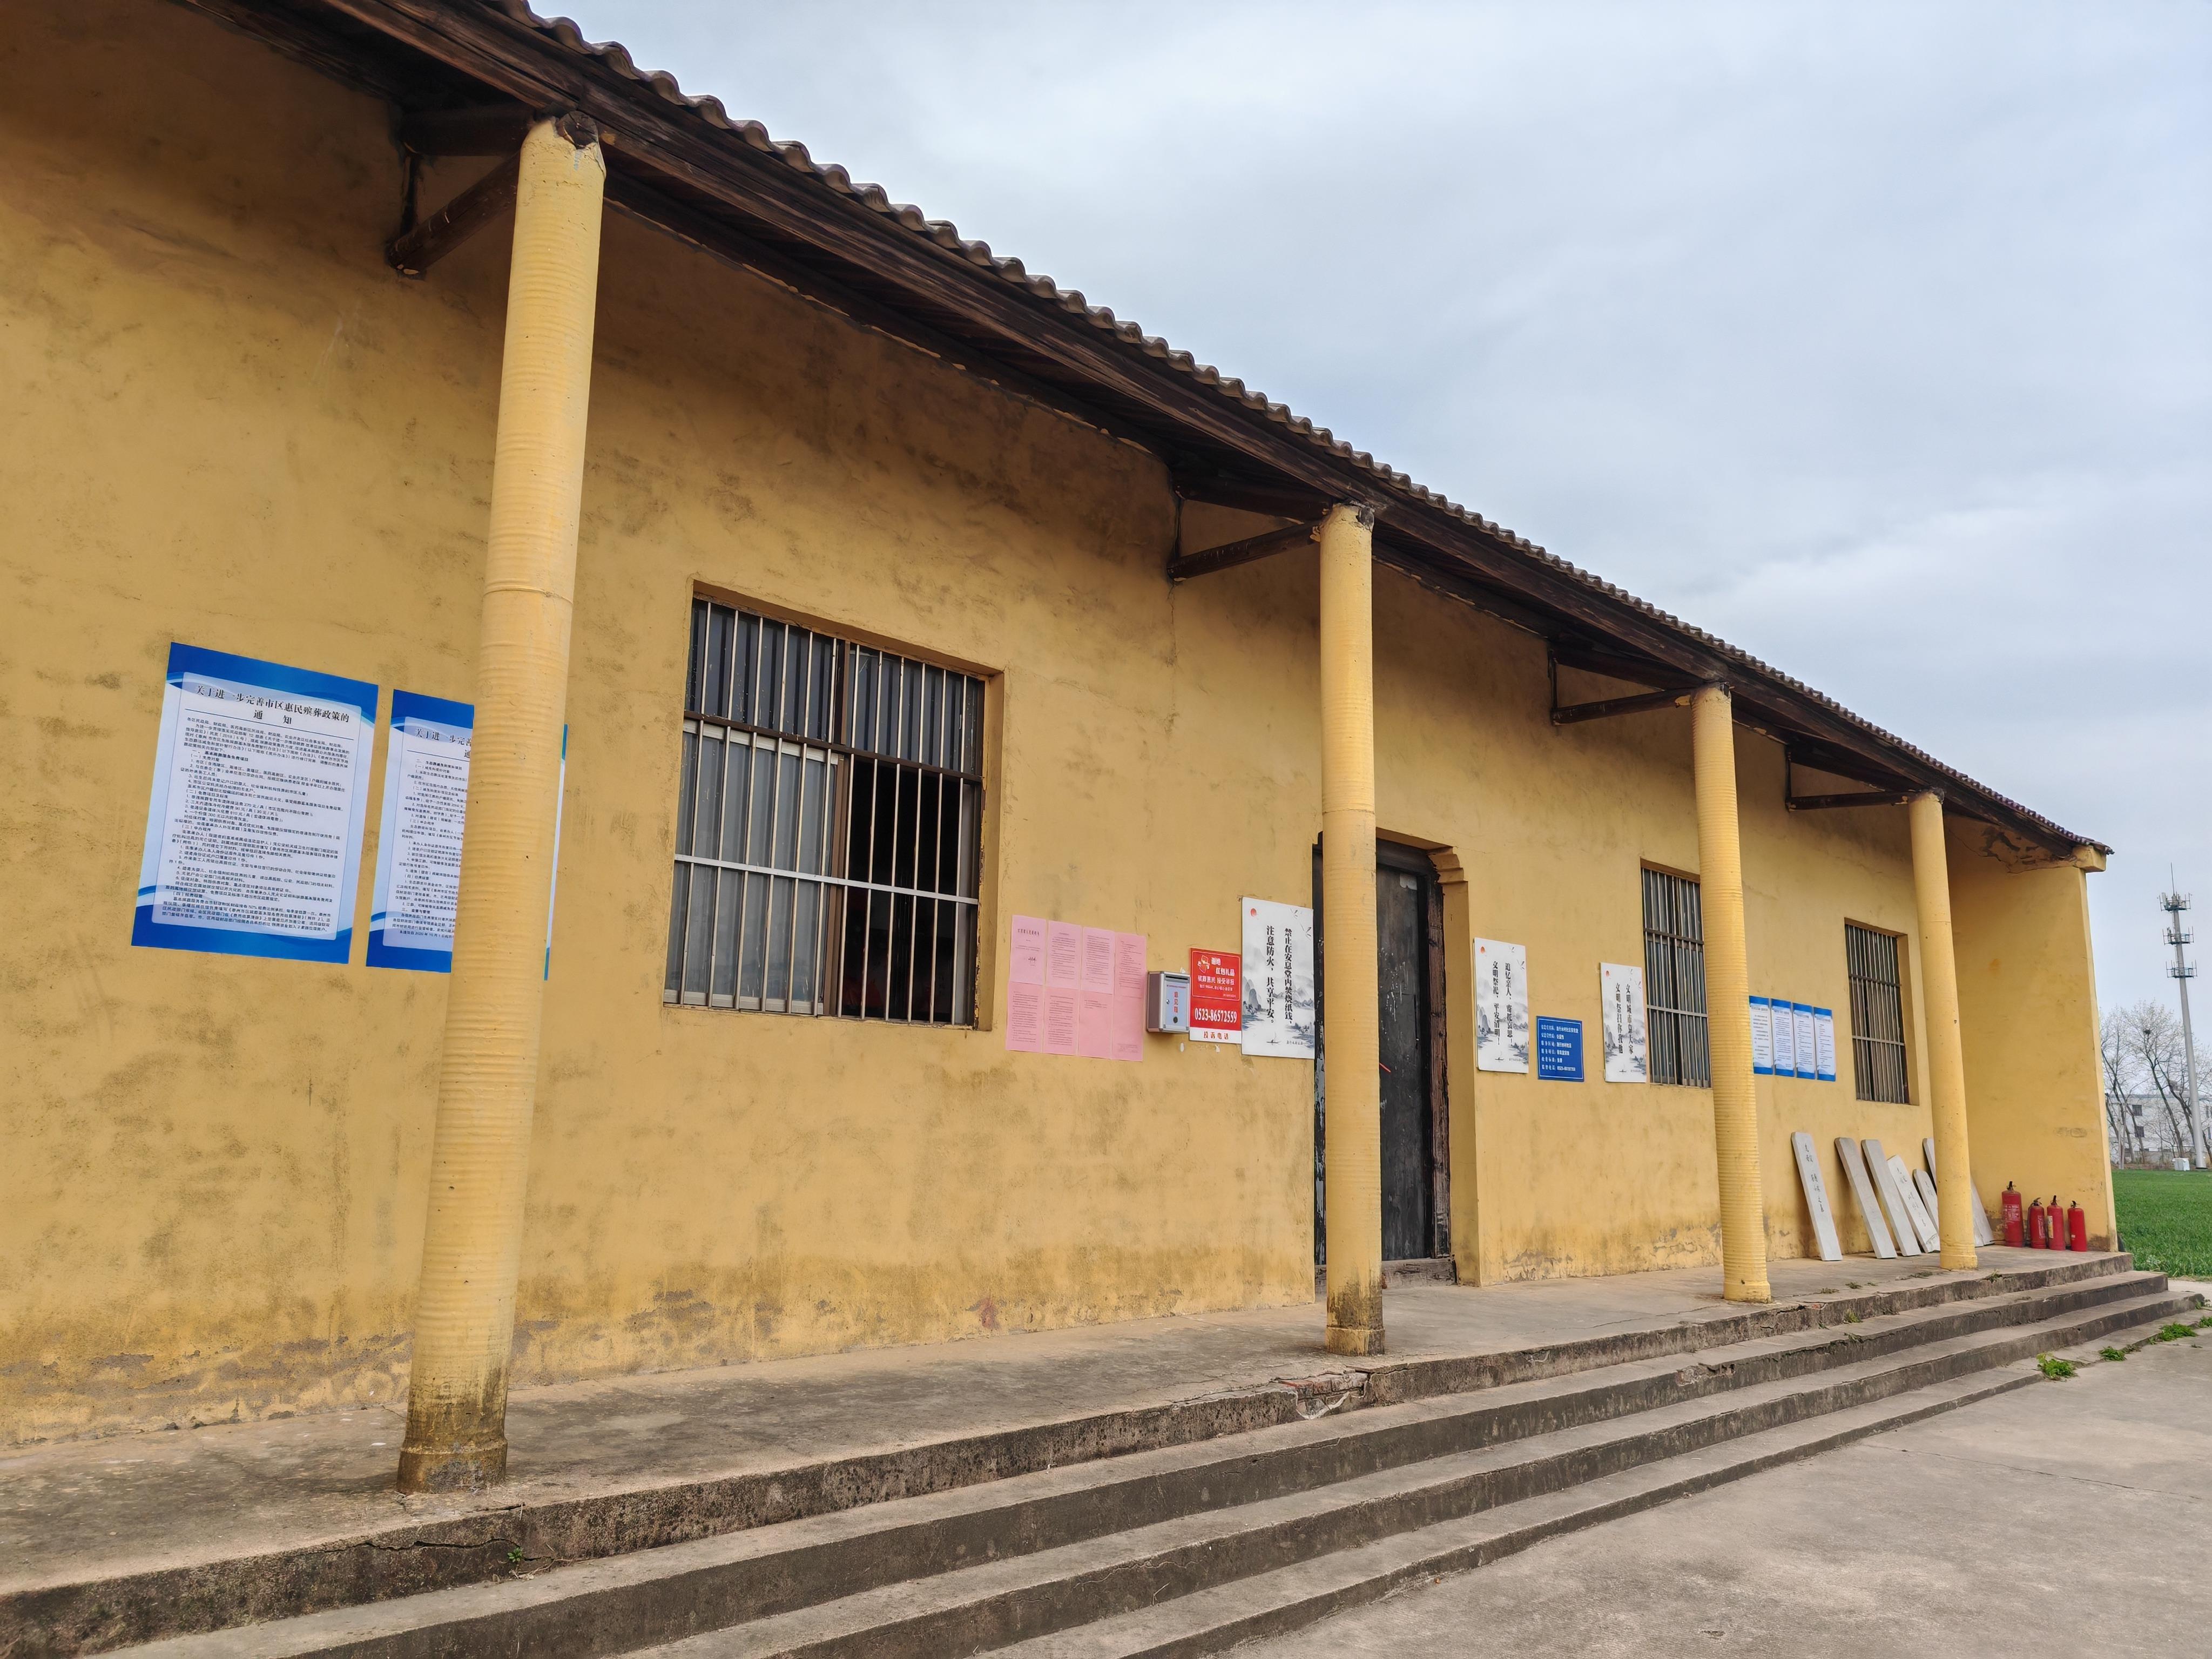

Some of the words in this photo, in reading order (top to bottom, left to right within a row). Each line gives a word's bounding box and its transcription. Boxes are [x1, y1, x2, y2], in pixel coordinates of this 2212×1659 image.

[195, 684, 349, 723] 关于进一步完善市区惠民殡葬政策的
[253, 709, 263, 720] 通
[282, 714, 292, 726] 知
[1266, 925, 1274, 1023] 注意防火，共享平安。
[1195, 1008, 1237, 1024] 0523-86572559
